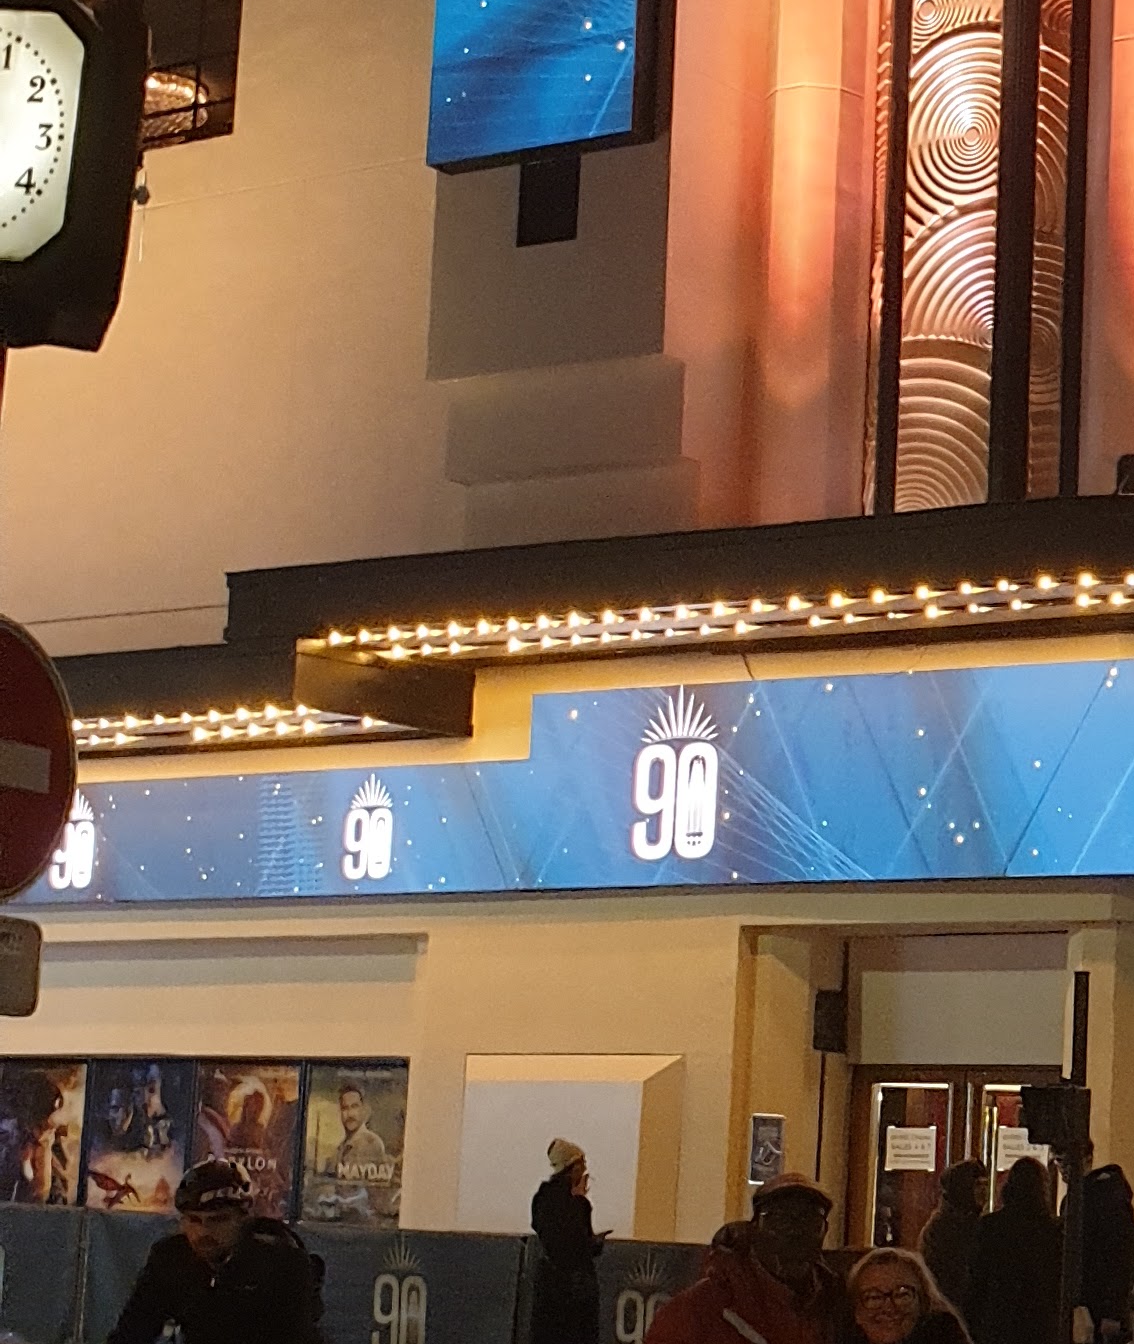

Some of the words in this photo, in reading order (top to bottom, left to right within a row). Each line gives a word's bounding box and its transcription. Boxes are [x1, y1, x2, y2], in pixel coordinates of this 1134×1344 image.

[1, 43, 13, 70] 1
[27, 75, 46, 103] 2
[35, 123, 53, 151] 3
[14, 166, 37, 195] 4
[631, 740, 718, 860] 90
[343, 807, 394, 880] 90
[337, 1162, 395, 1181] MAYDAY
